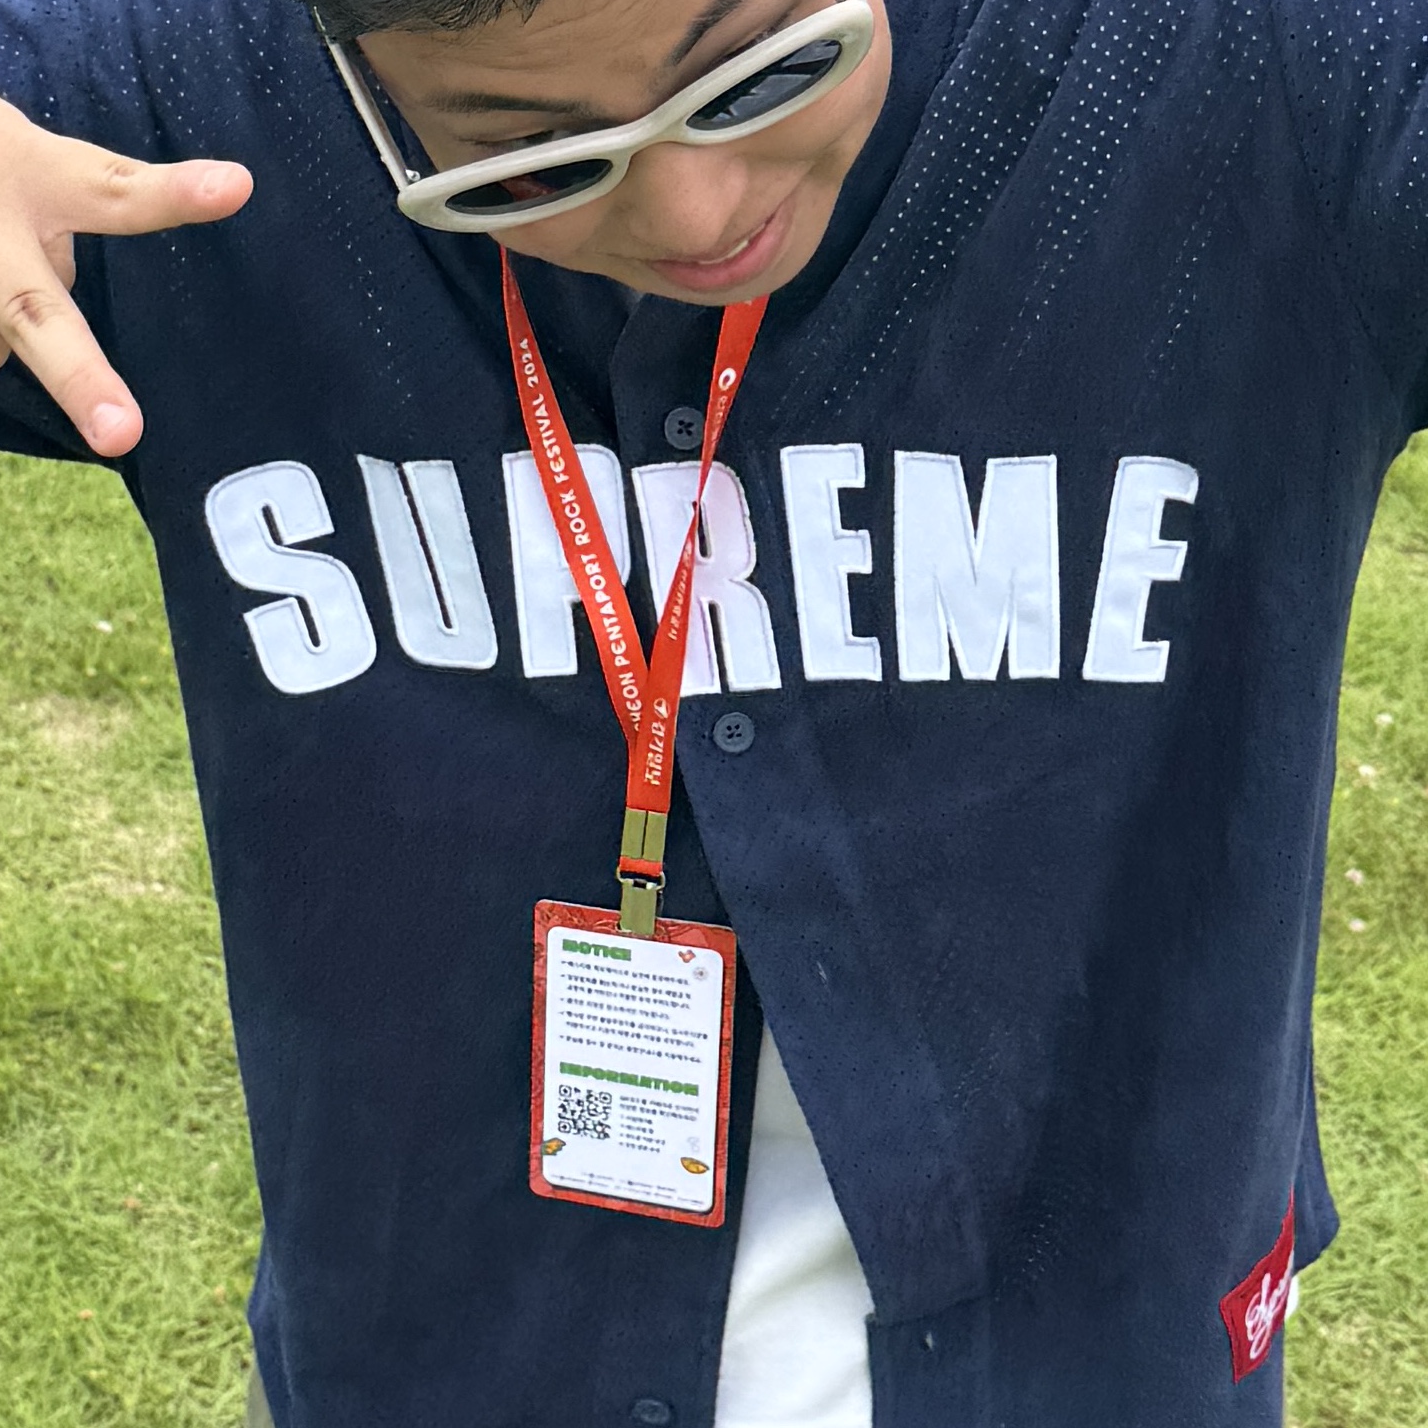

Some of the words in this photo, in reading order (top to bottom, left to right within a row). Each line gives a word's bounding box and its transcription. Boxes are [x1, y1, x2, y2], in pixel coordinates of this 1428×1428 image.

[532, 393, 570, 484] FESTIVAL
[559, 488, 591, 546] ROCK
[203, 440, 1200, 696] SUPREME
[580, 552, 631, 668] PENTAPORT
[621, 672, 642, 731] HEON
[561, 937, 632, 962] NOTICE
